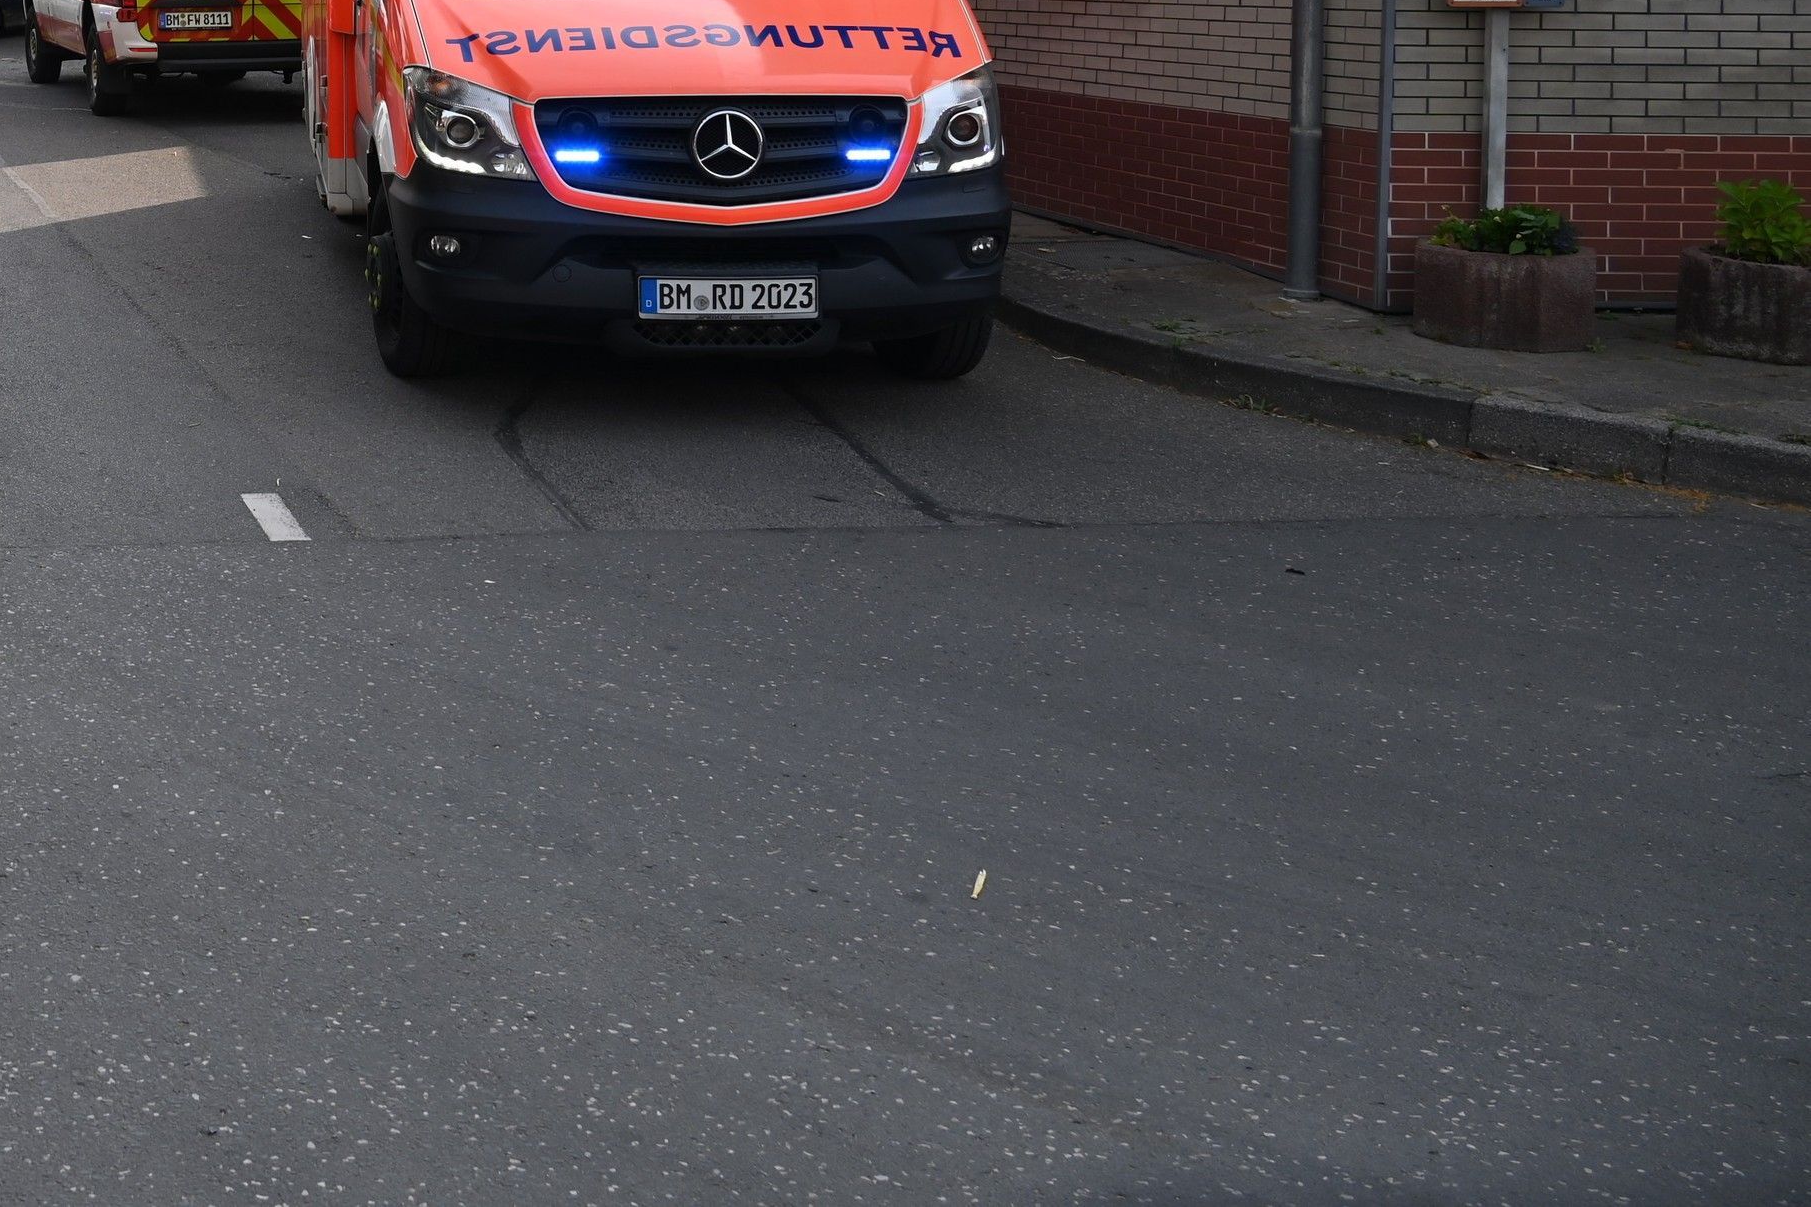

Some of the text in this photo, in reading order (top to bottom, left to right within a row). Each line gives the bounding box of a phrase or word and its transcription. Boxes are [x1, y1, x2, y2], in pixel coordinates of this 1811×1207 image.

[165, 12, 230, 26] BM FW 8111
[658, 282, 692, 310] BM
[711, 282, 745, 311] RD
[750, 281, 814, 311] 2023
